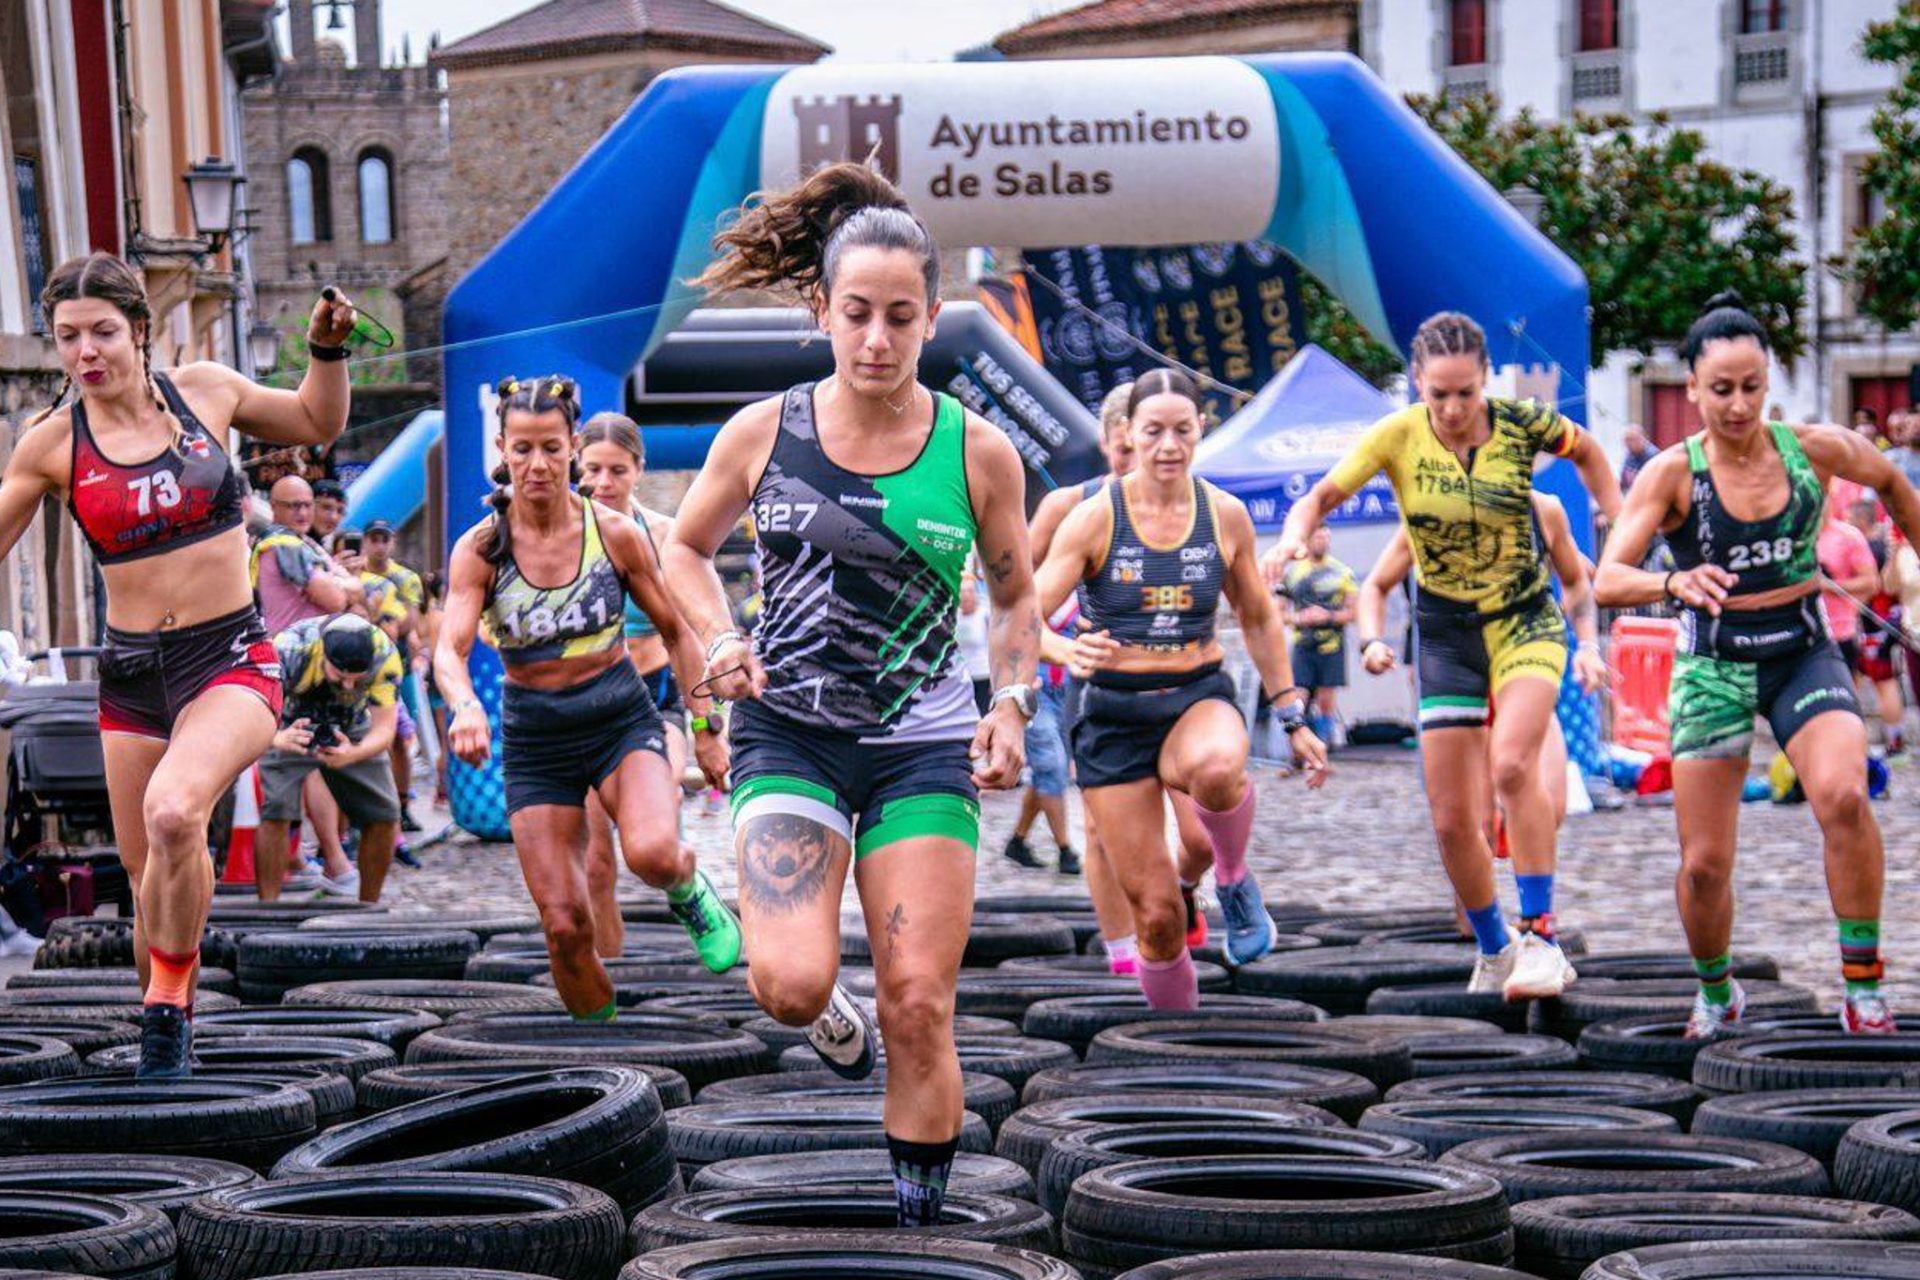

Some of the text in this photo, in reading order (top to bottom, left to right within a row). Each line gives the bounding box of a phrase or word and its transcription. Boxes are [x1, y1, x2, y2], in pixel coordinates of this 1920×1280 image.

[930, 110, 1249, 158] Ayuntamiento
[929, 161, 1113, 198] de Salas
[1210, 284, 1253, 380] RACE
[973, 351, 1014, 395] TUS
[1003, 385, 1071, 447] SERIES
[1417, 457, 1457, 473] Alba
[127, 469, 182, 517] 73
[756, 503, 819, 533] 327
[1727, 536, 1793, 571] 238
[504, 597, 608, 639] 1841
[1140, 584, 1195, 613] 386
